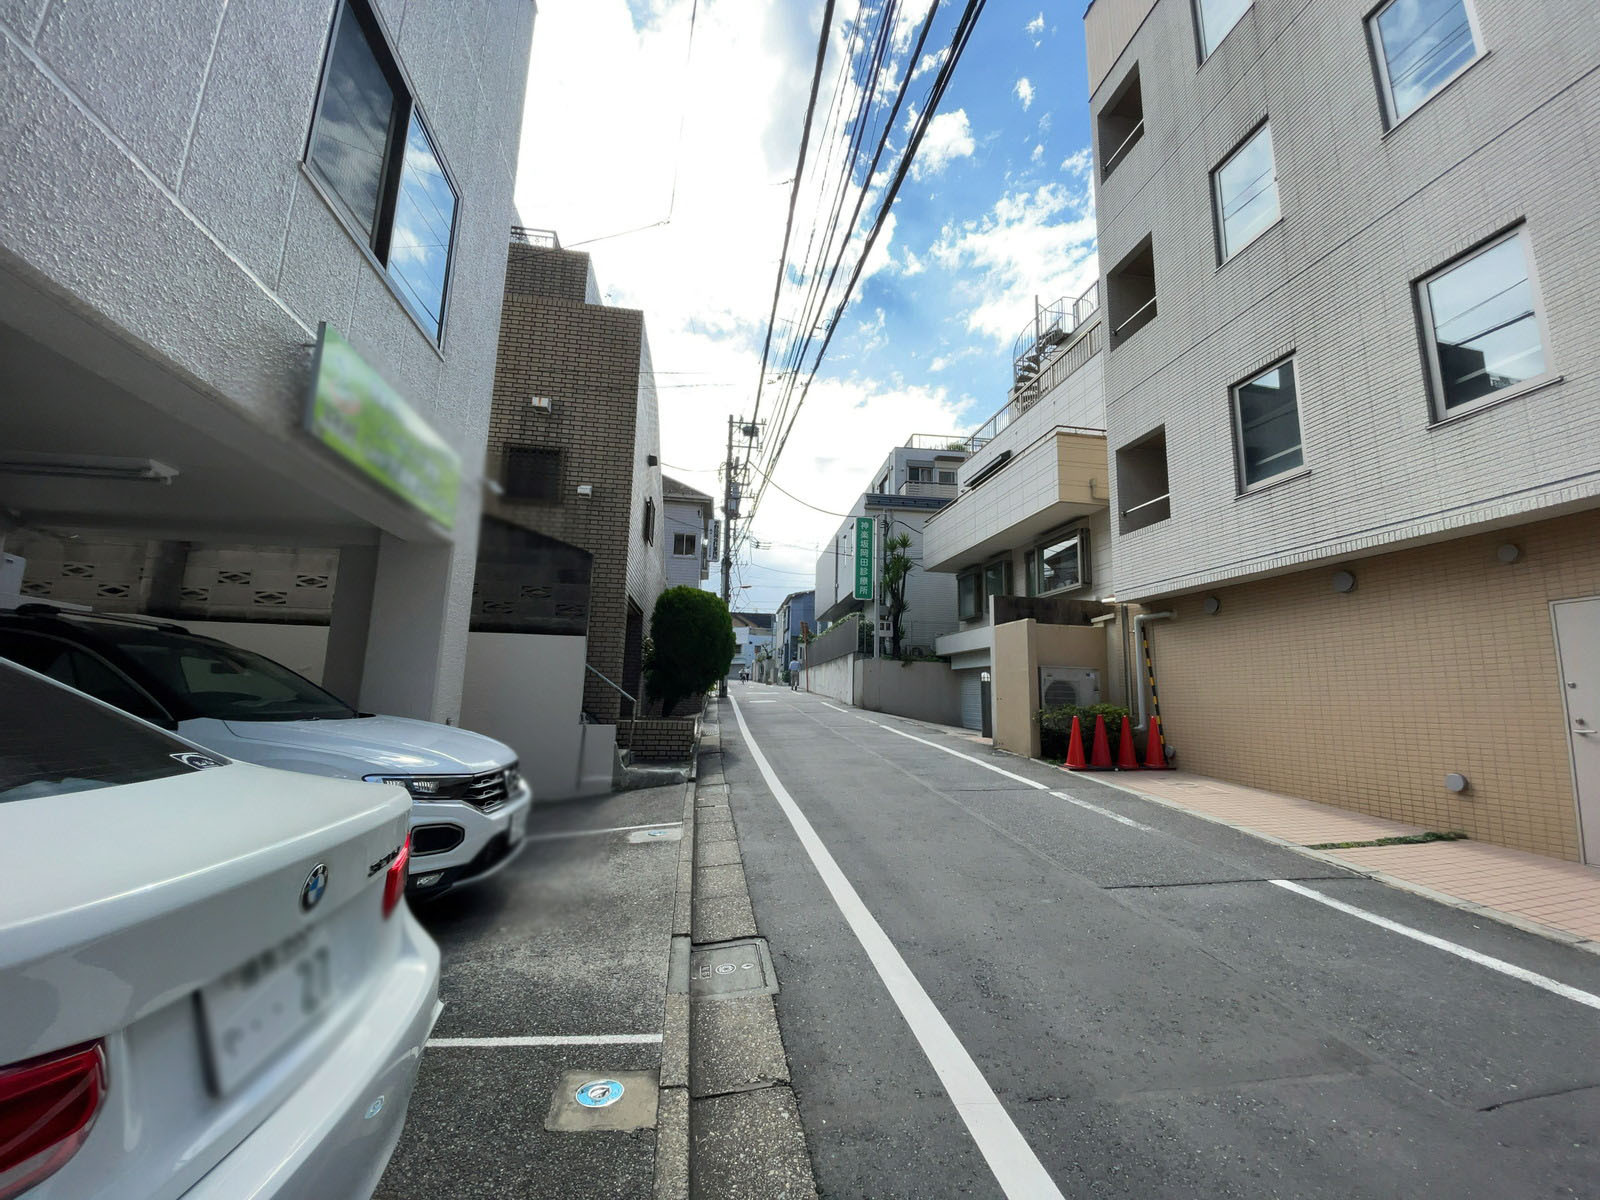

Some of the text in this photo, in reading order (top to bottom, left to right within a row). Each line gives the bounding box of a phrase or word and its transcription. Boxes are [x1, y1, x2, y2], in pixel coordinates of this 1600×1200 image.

[859, 521, 870, 595] 神楽坂岡田診療所
